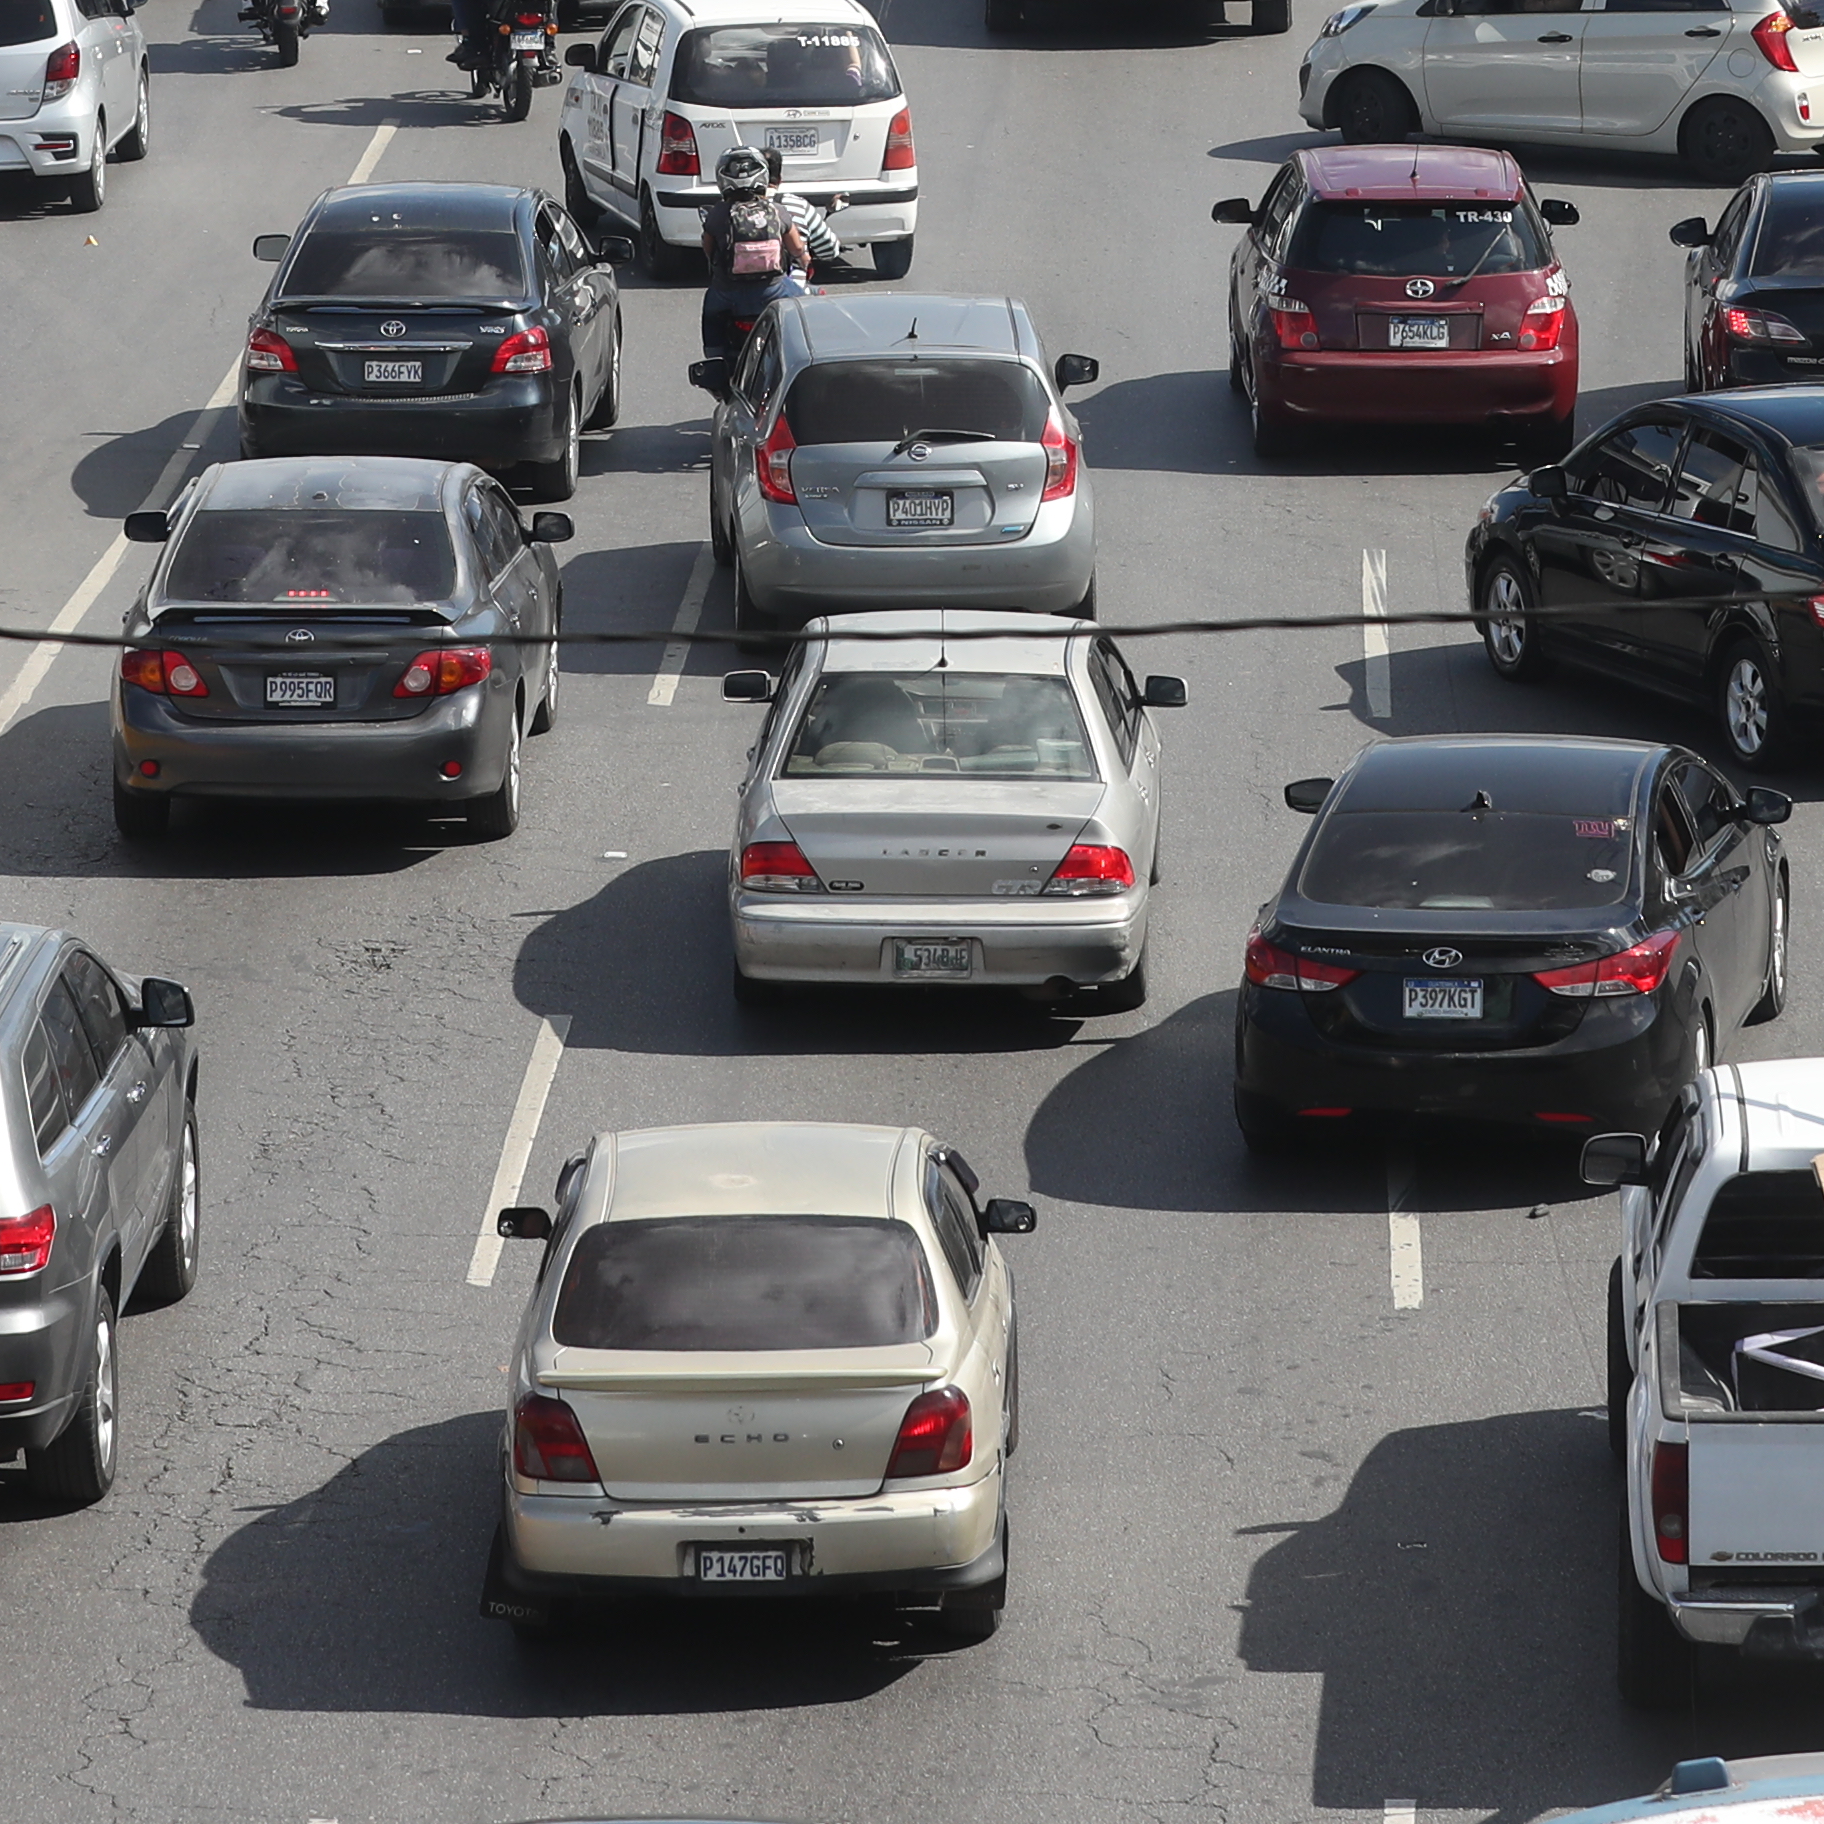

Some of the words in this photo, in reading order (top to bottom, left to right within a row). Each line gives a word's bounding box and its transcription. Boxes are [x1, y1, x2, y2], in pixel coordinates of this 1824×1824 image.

[796, 36, 860, 48] T-11885
[768, 134, 817, 149] A135BCG
[1455, 209, 1513, 224] TR-430
[1392, 324, 1446, 342] P654KLG
[366, 364, 422, 381] P366FYK
[268, 678, 333, 700] P995FQR
[881, 849, 988, 858] LANCER
[1407, 989, 1479, 1010] P397KGT
[694, 1433, 790, 1444] ECHO
[1735, 1551, 1818, 1561] COLORADO
[703, 1552, 786, 1579] P147GFQ
